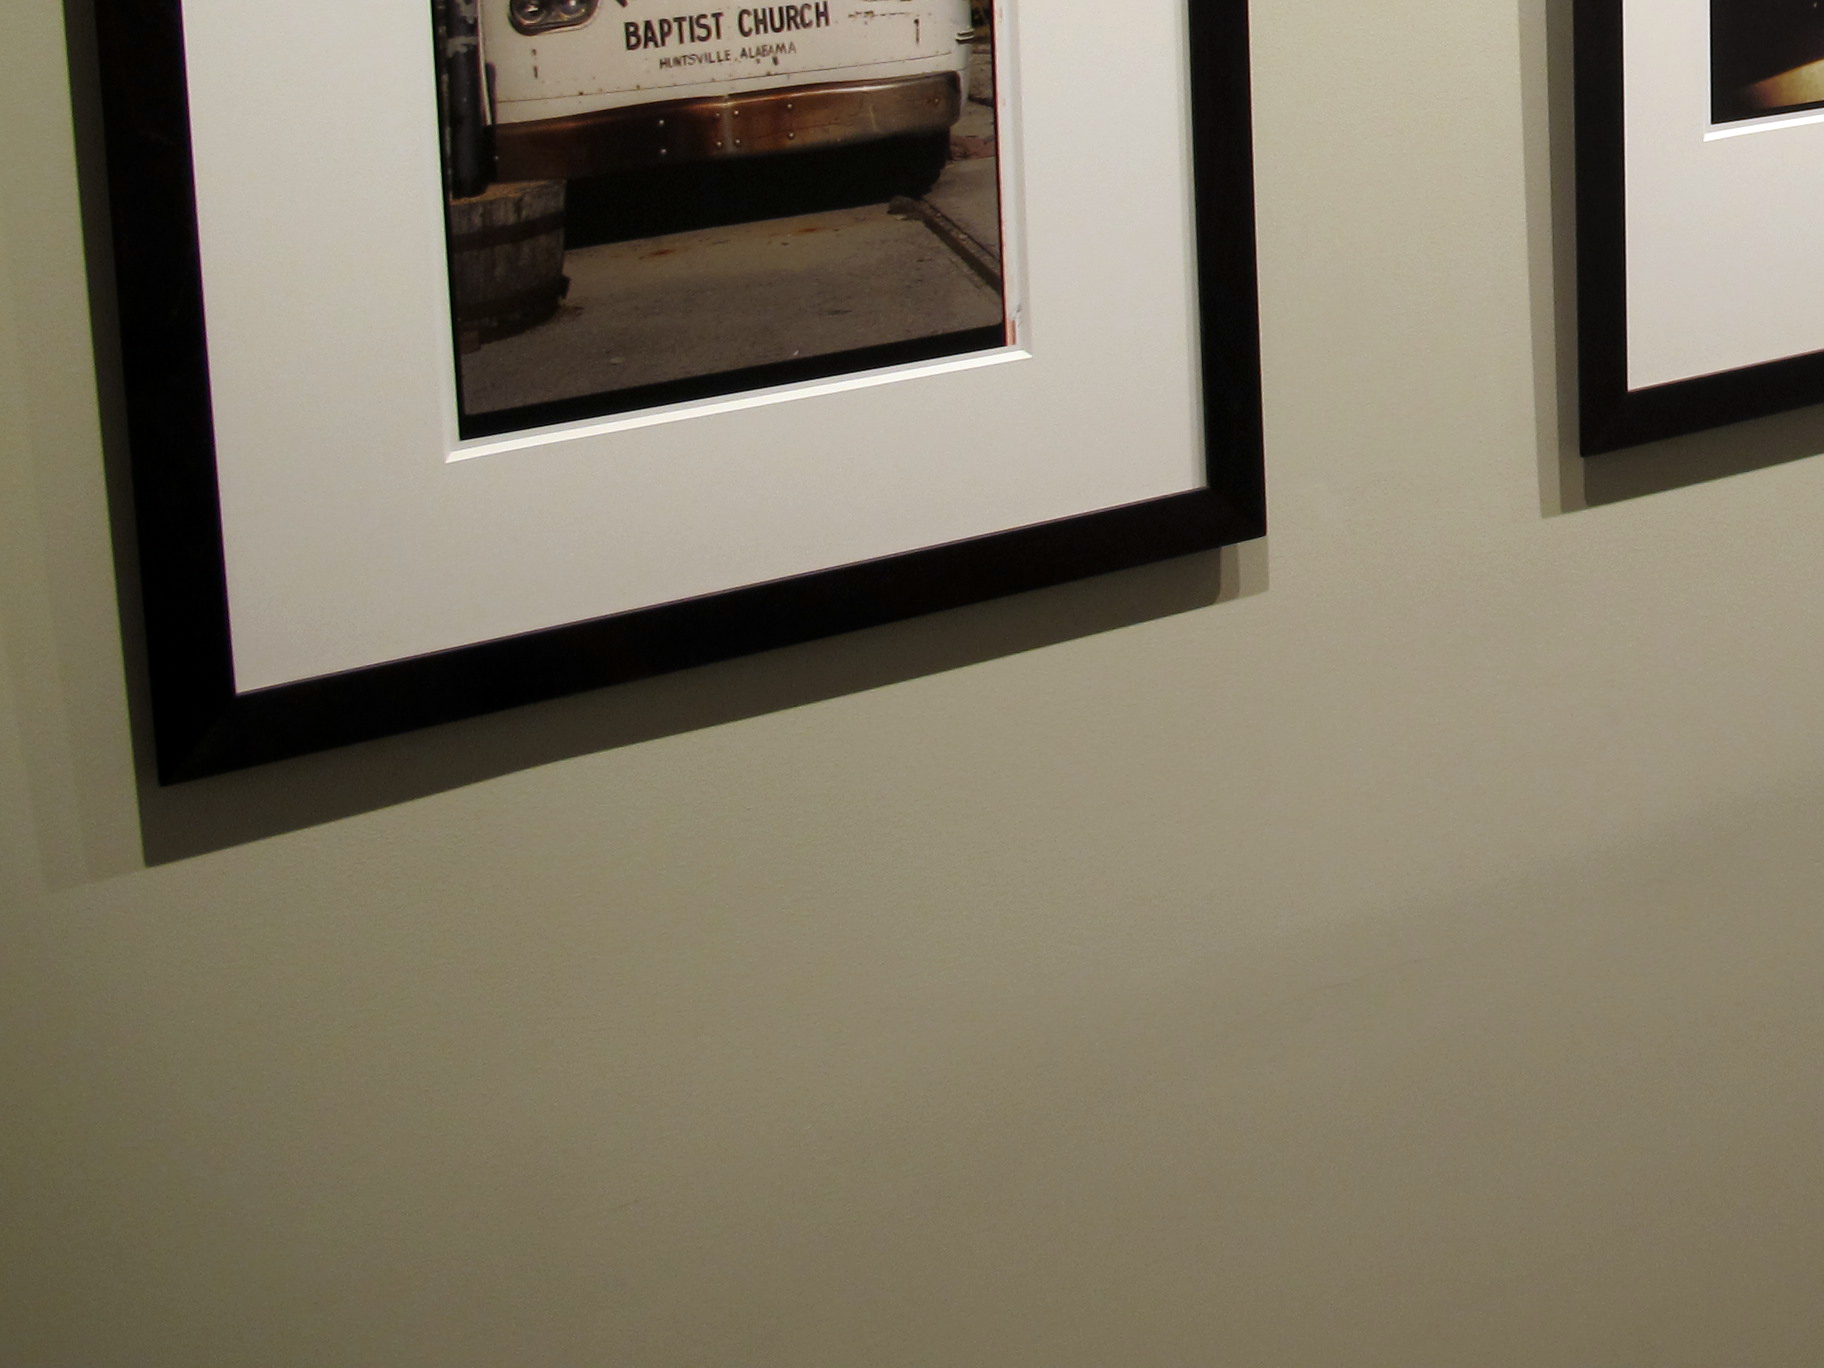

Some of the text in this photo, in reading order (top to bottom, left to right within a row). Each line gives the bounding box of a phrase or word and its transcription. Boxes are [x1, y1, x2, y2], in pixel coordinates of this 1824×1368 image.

[624, 0, 830, 51] BAPTIST CHURCH
[740, 41, 797, 59] ALABAMA
